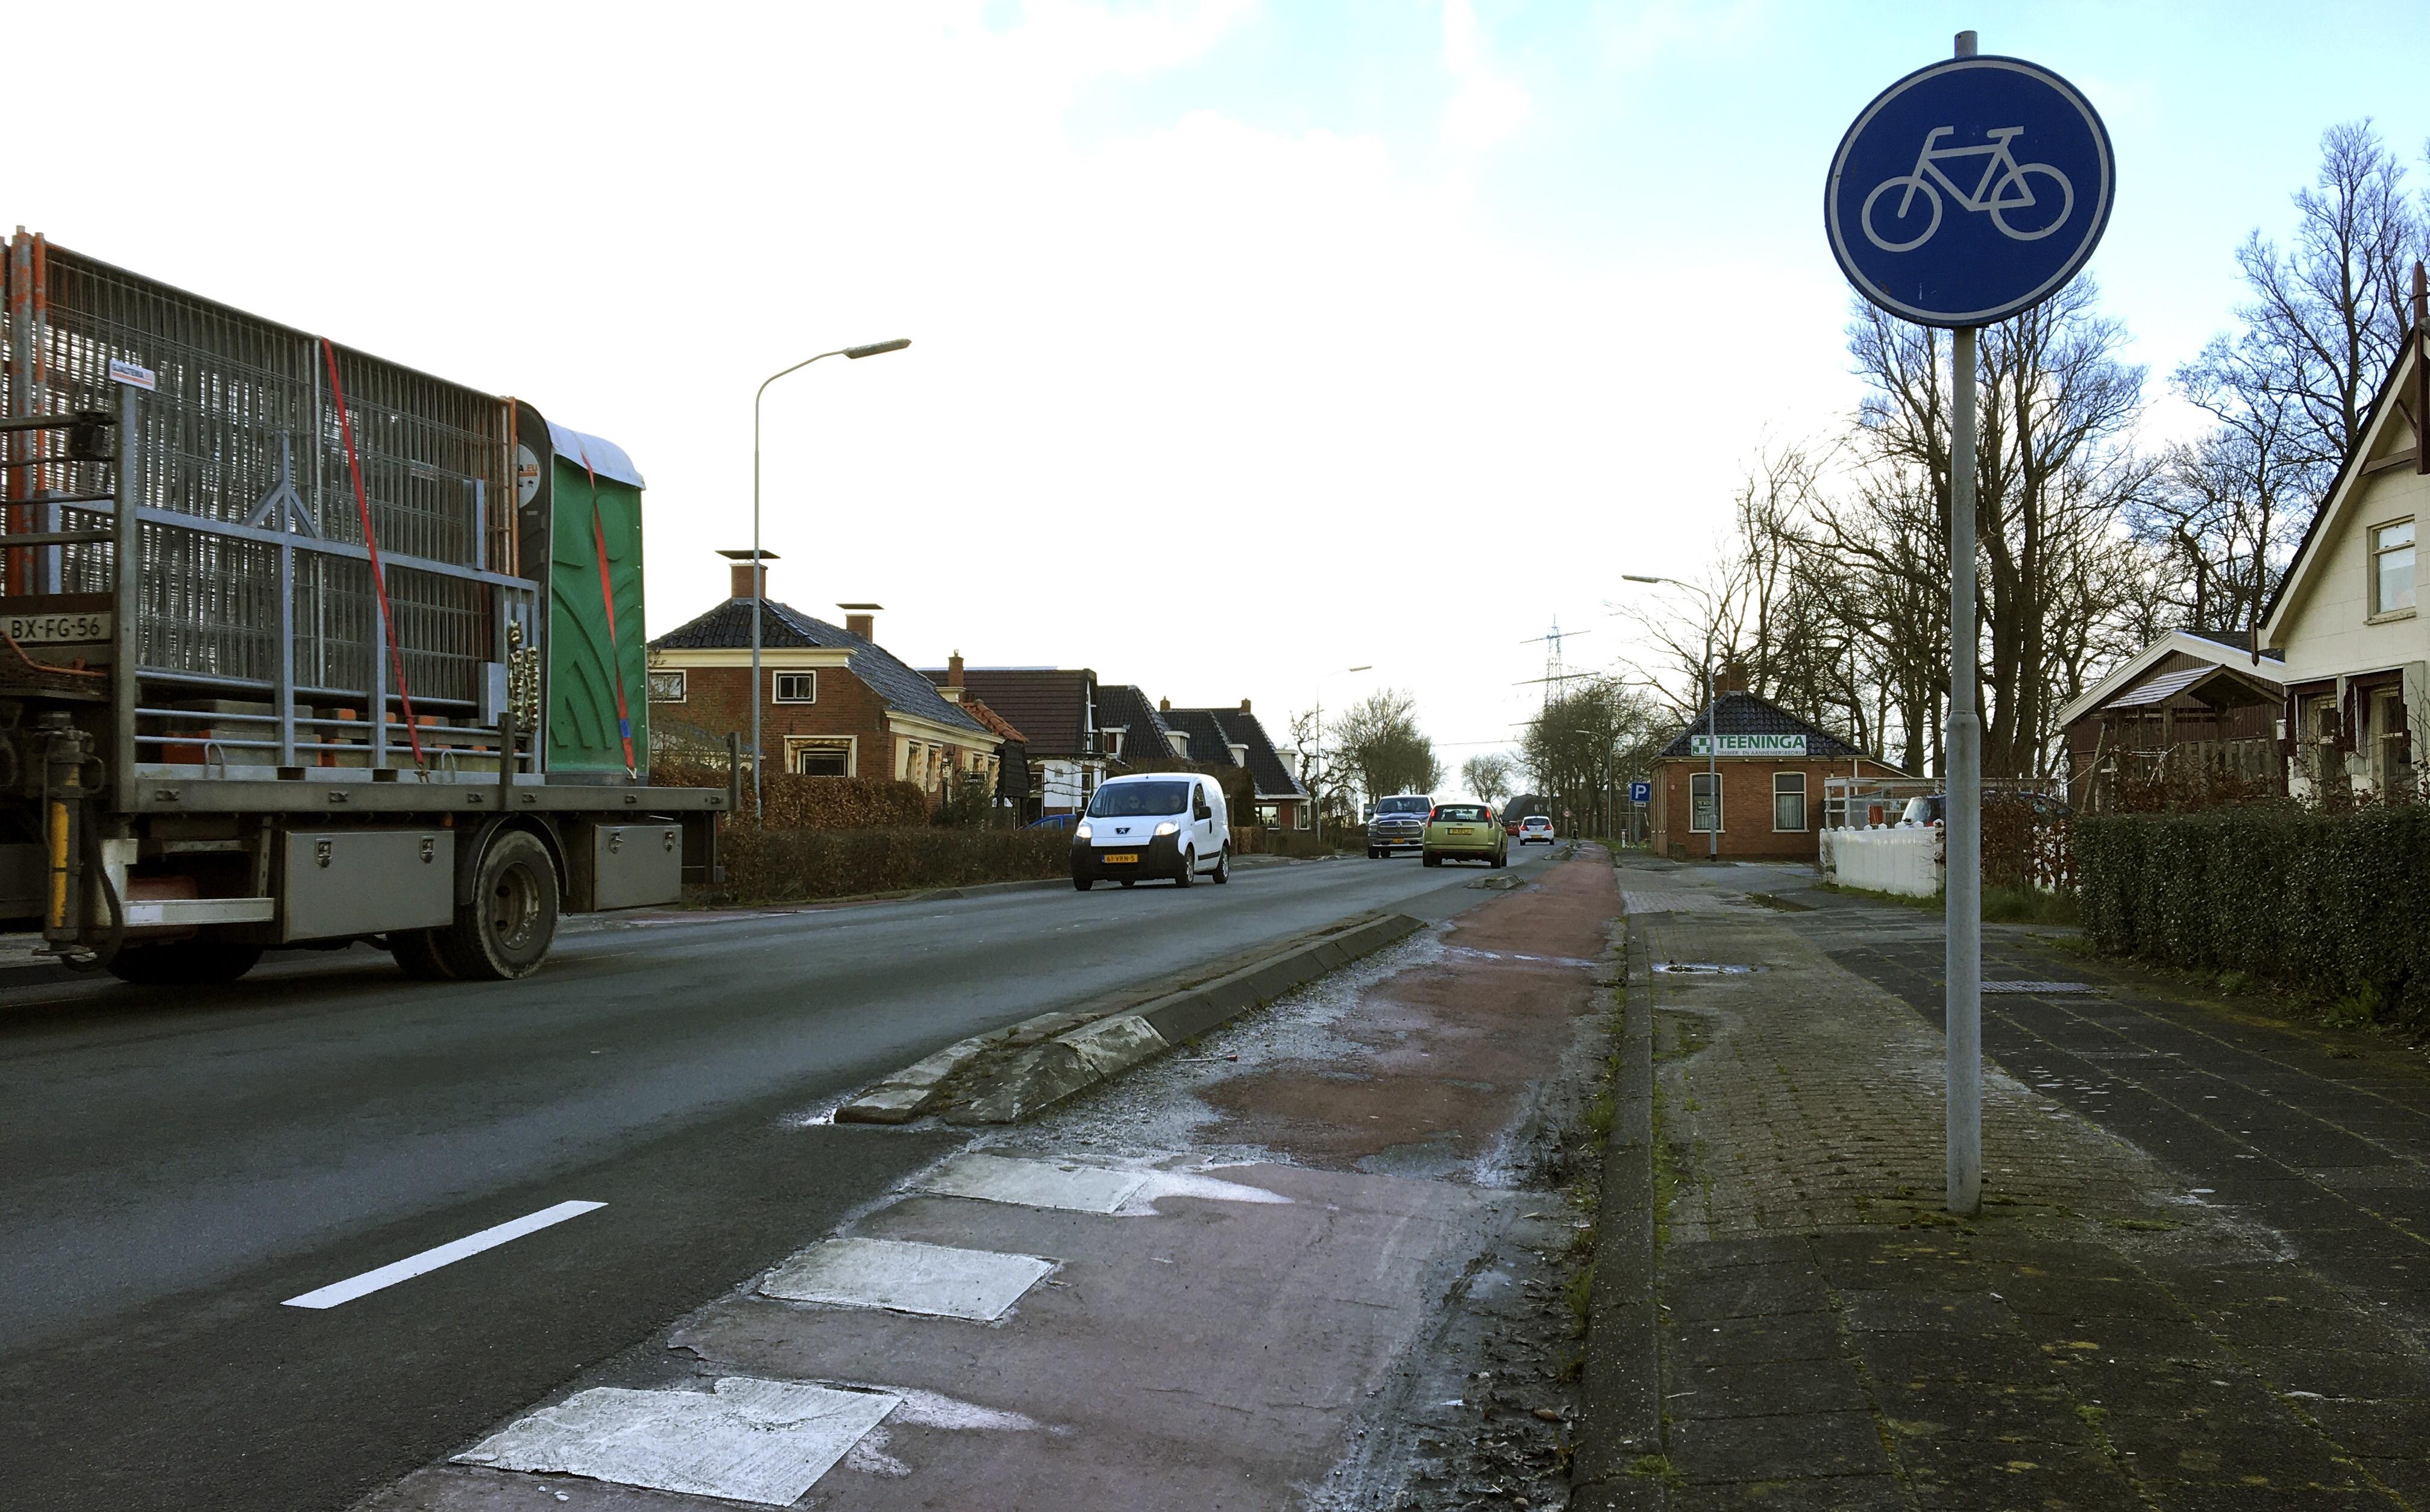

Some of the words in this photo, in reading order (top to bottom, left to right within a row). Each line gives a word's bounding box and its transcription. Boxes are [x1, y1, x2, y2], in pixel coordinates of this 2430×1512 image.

[11, 617, 100, 638] BX-FG-56
[1716, 735, 1806, 748] TEENINGA
[1635, 785, 1647, 798] P
